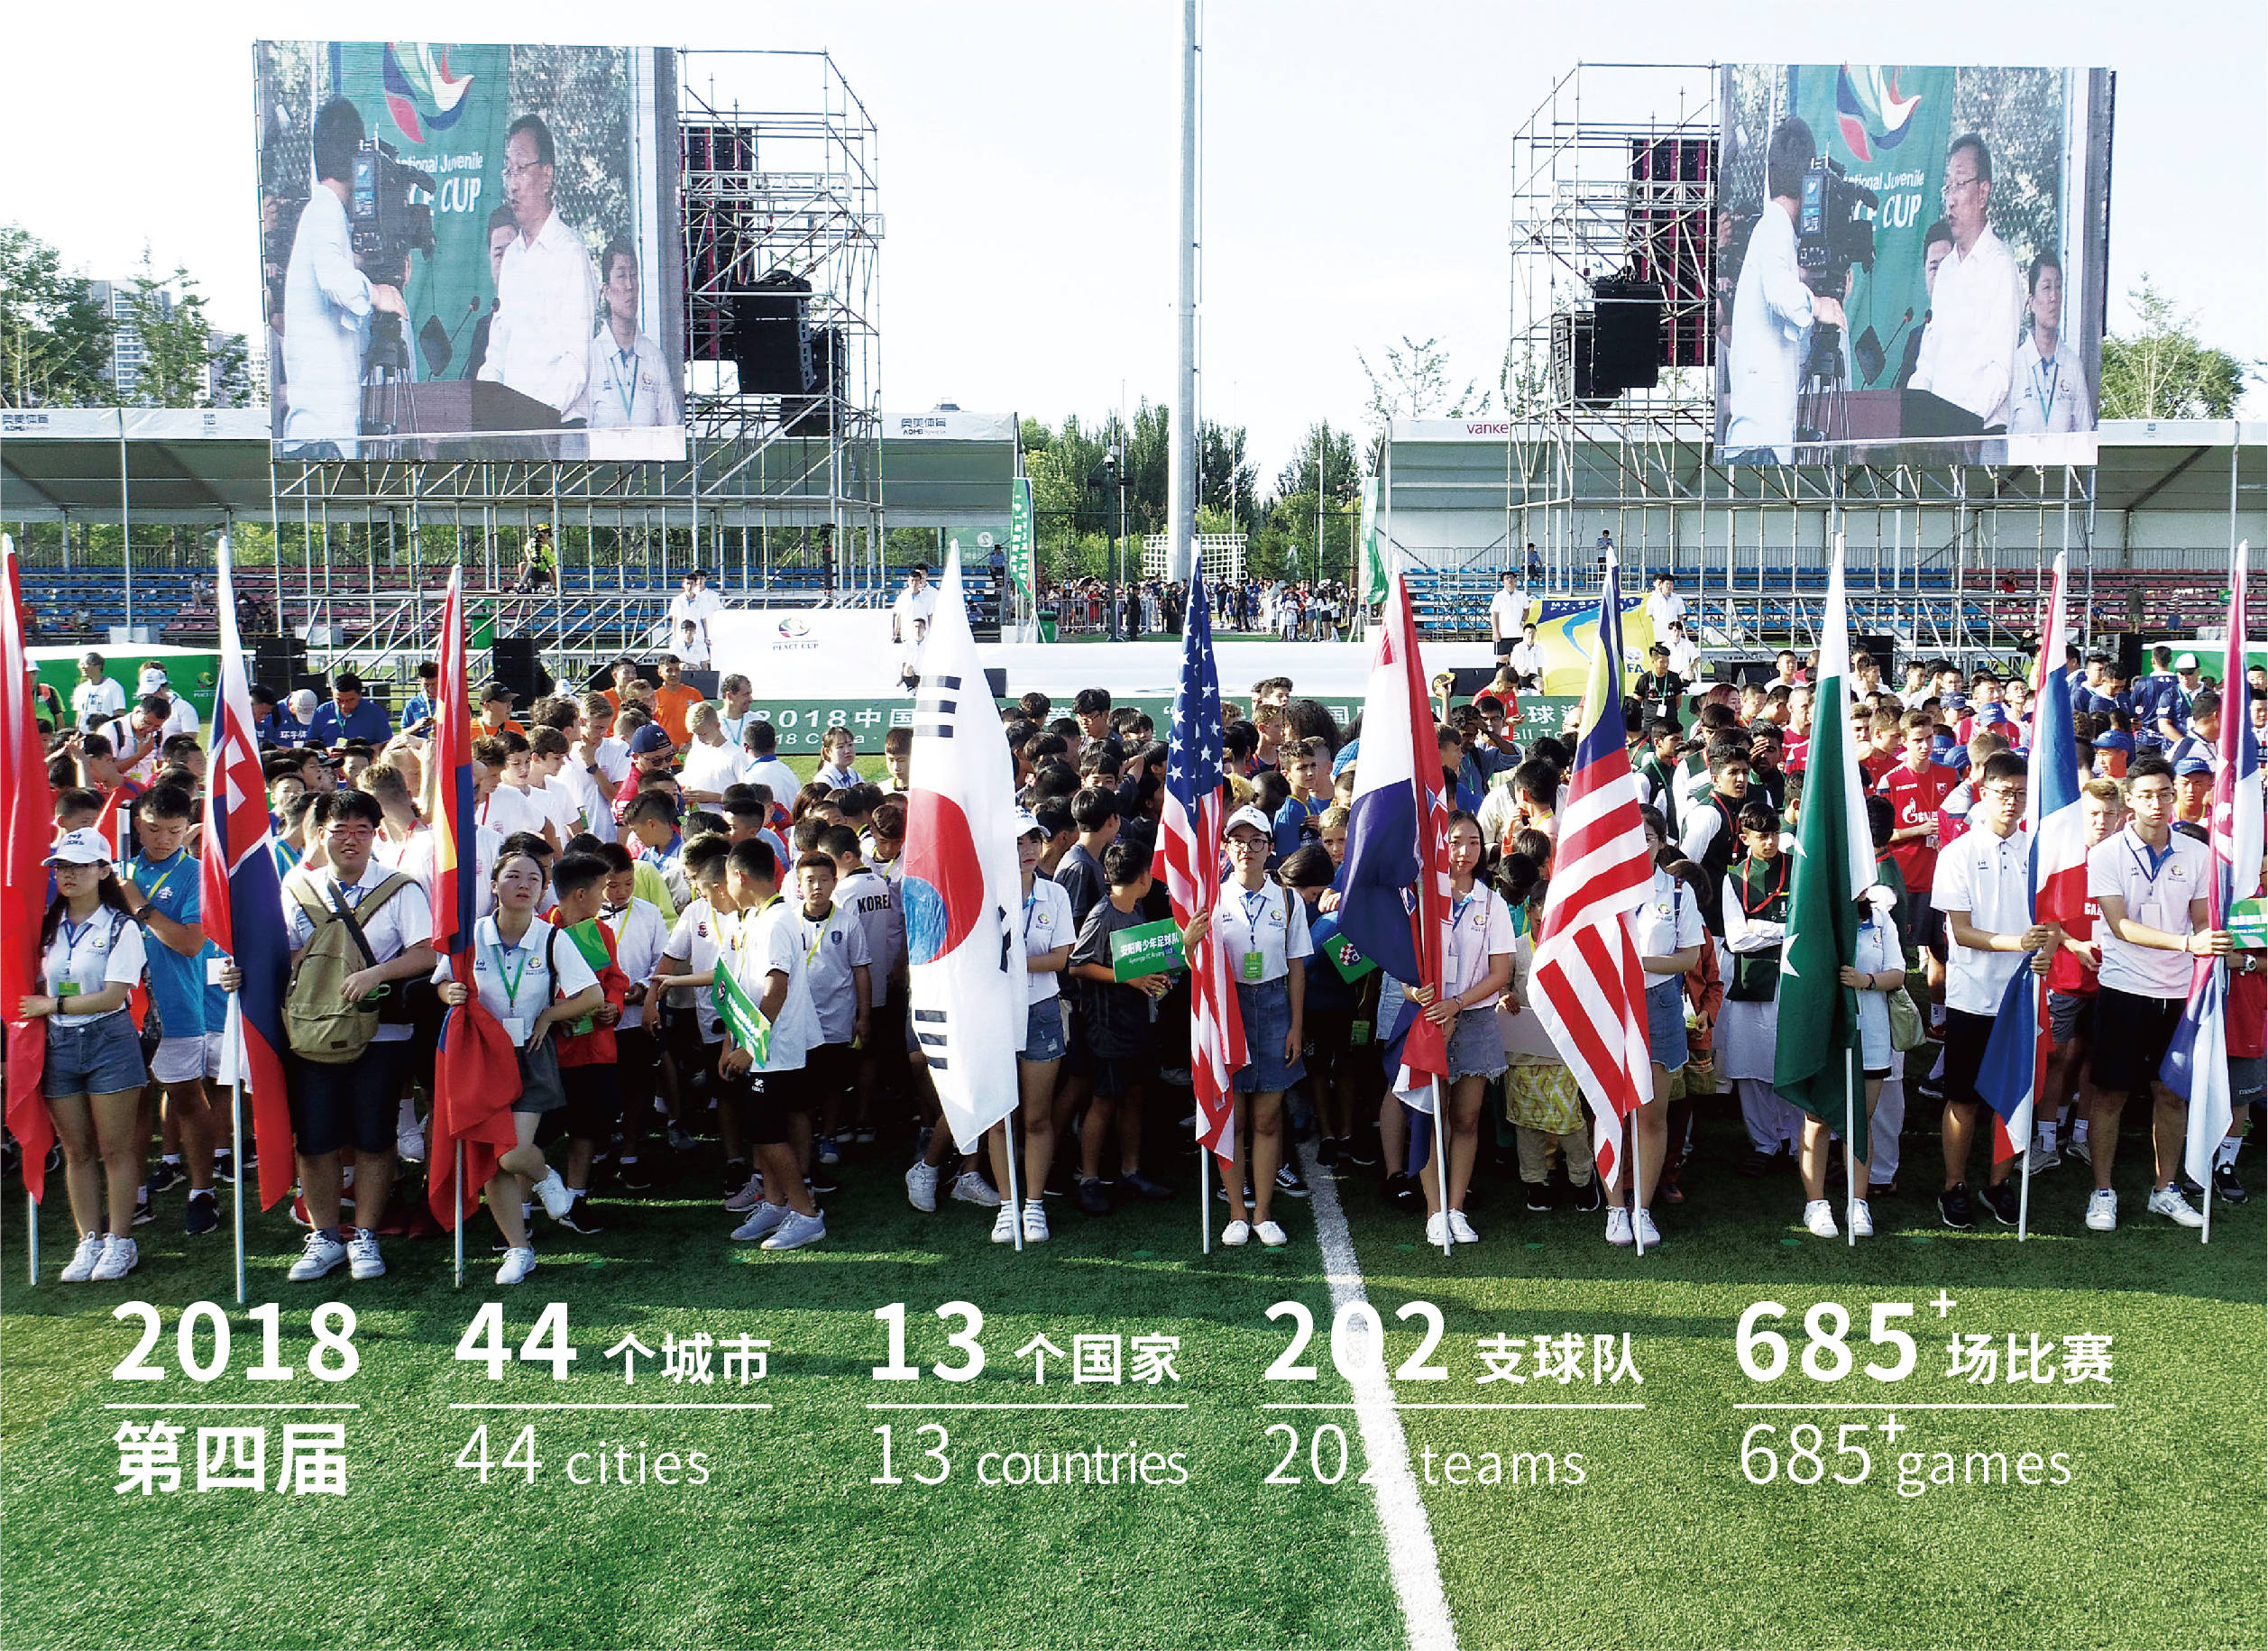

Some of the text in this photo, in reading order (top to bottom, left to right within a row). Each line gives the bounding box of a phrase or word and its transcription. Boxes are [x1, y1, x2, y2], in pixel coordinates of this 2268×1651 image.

[439, 151, 483, 173] Juvenile
[1883, 170, 1924, 190] Juvenile
[440, 178, 482, 213] CUP
[1883, 194, 1923, 228] CUP
[1466, 423, 1509, 434] vanke
